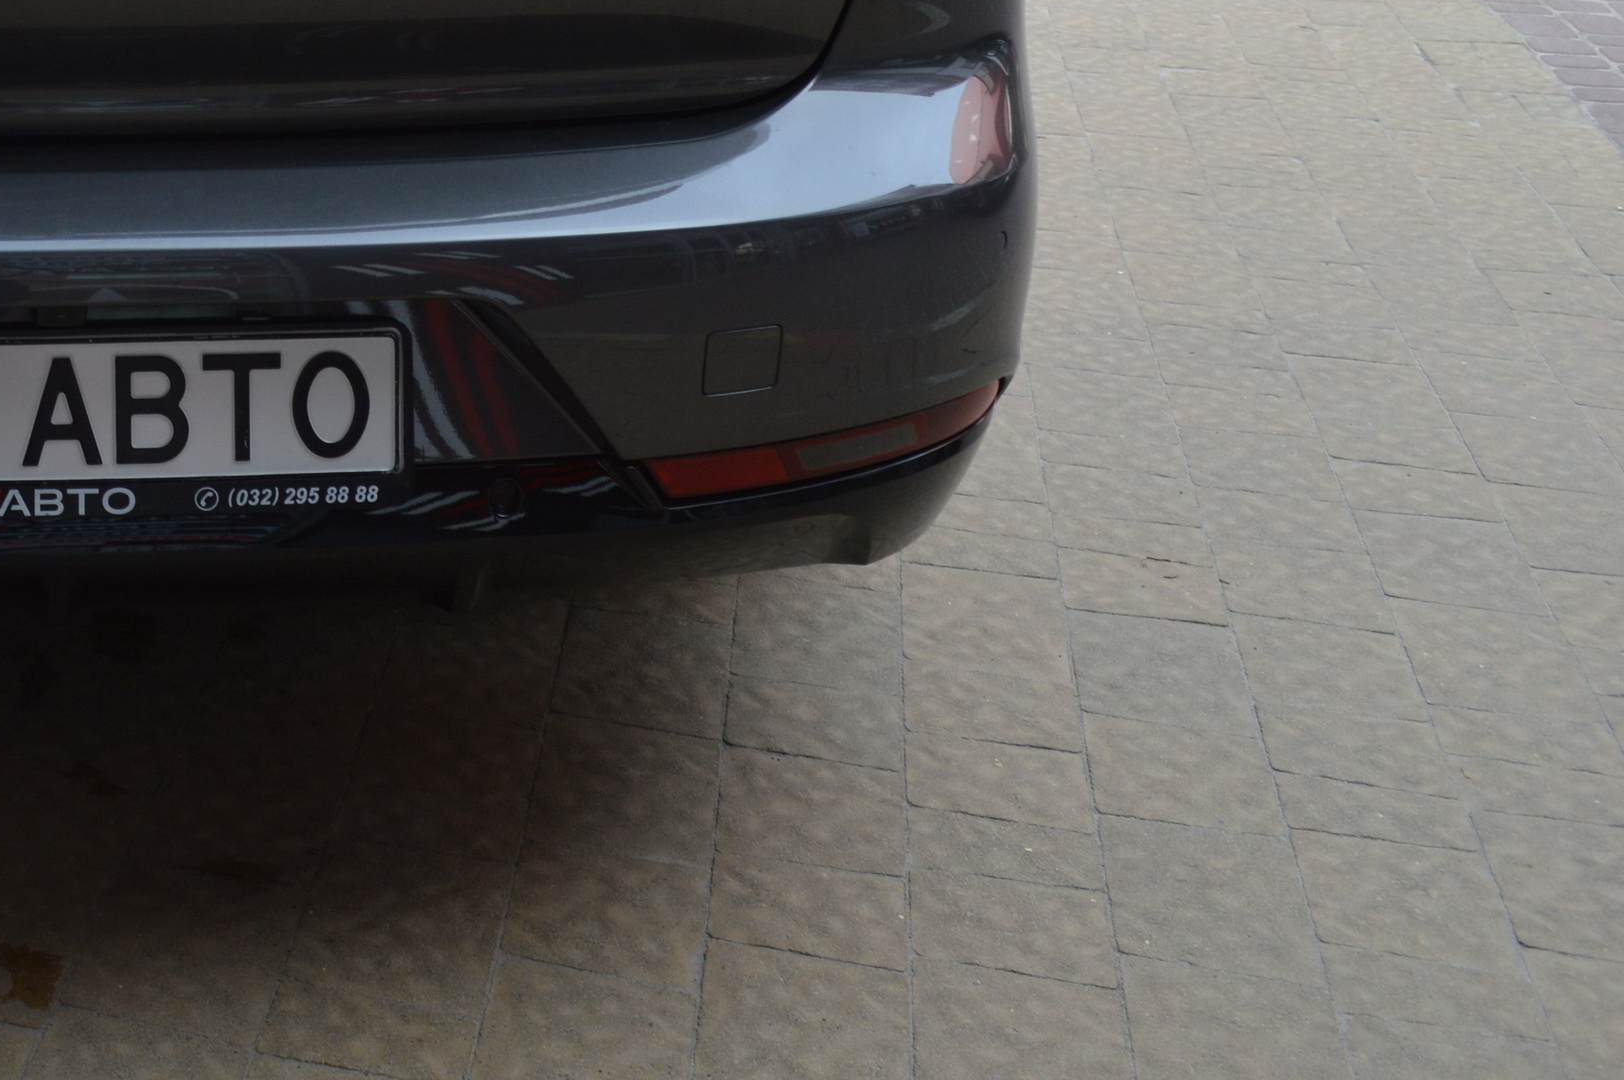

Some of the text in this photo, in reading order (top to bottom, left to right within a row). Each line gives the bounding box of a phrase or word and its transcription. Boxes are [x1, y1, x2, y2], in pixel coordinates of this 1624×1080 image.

[22, 350, 371, 469] АВТО
[227, 485, 380, 508] (032) 295 88 88
